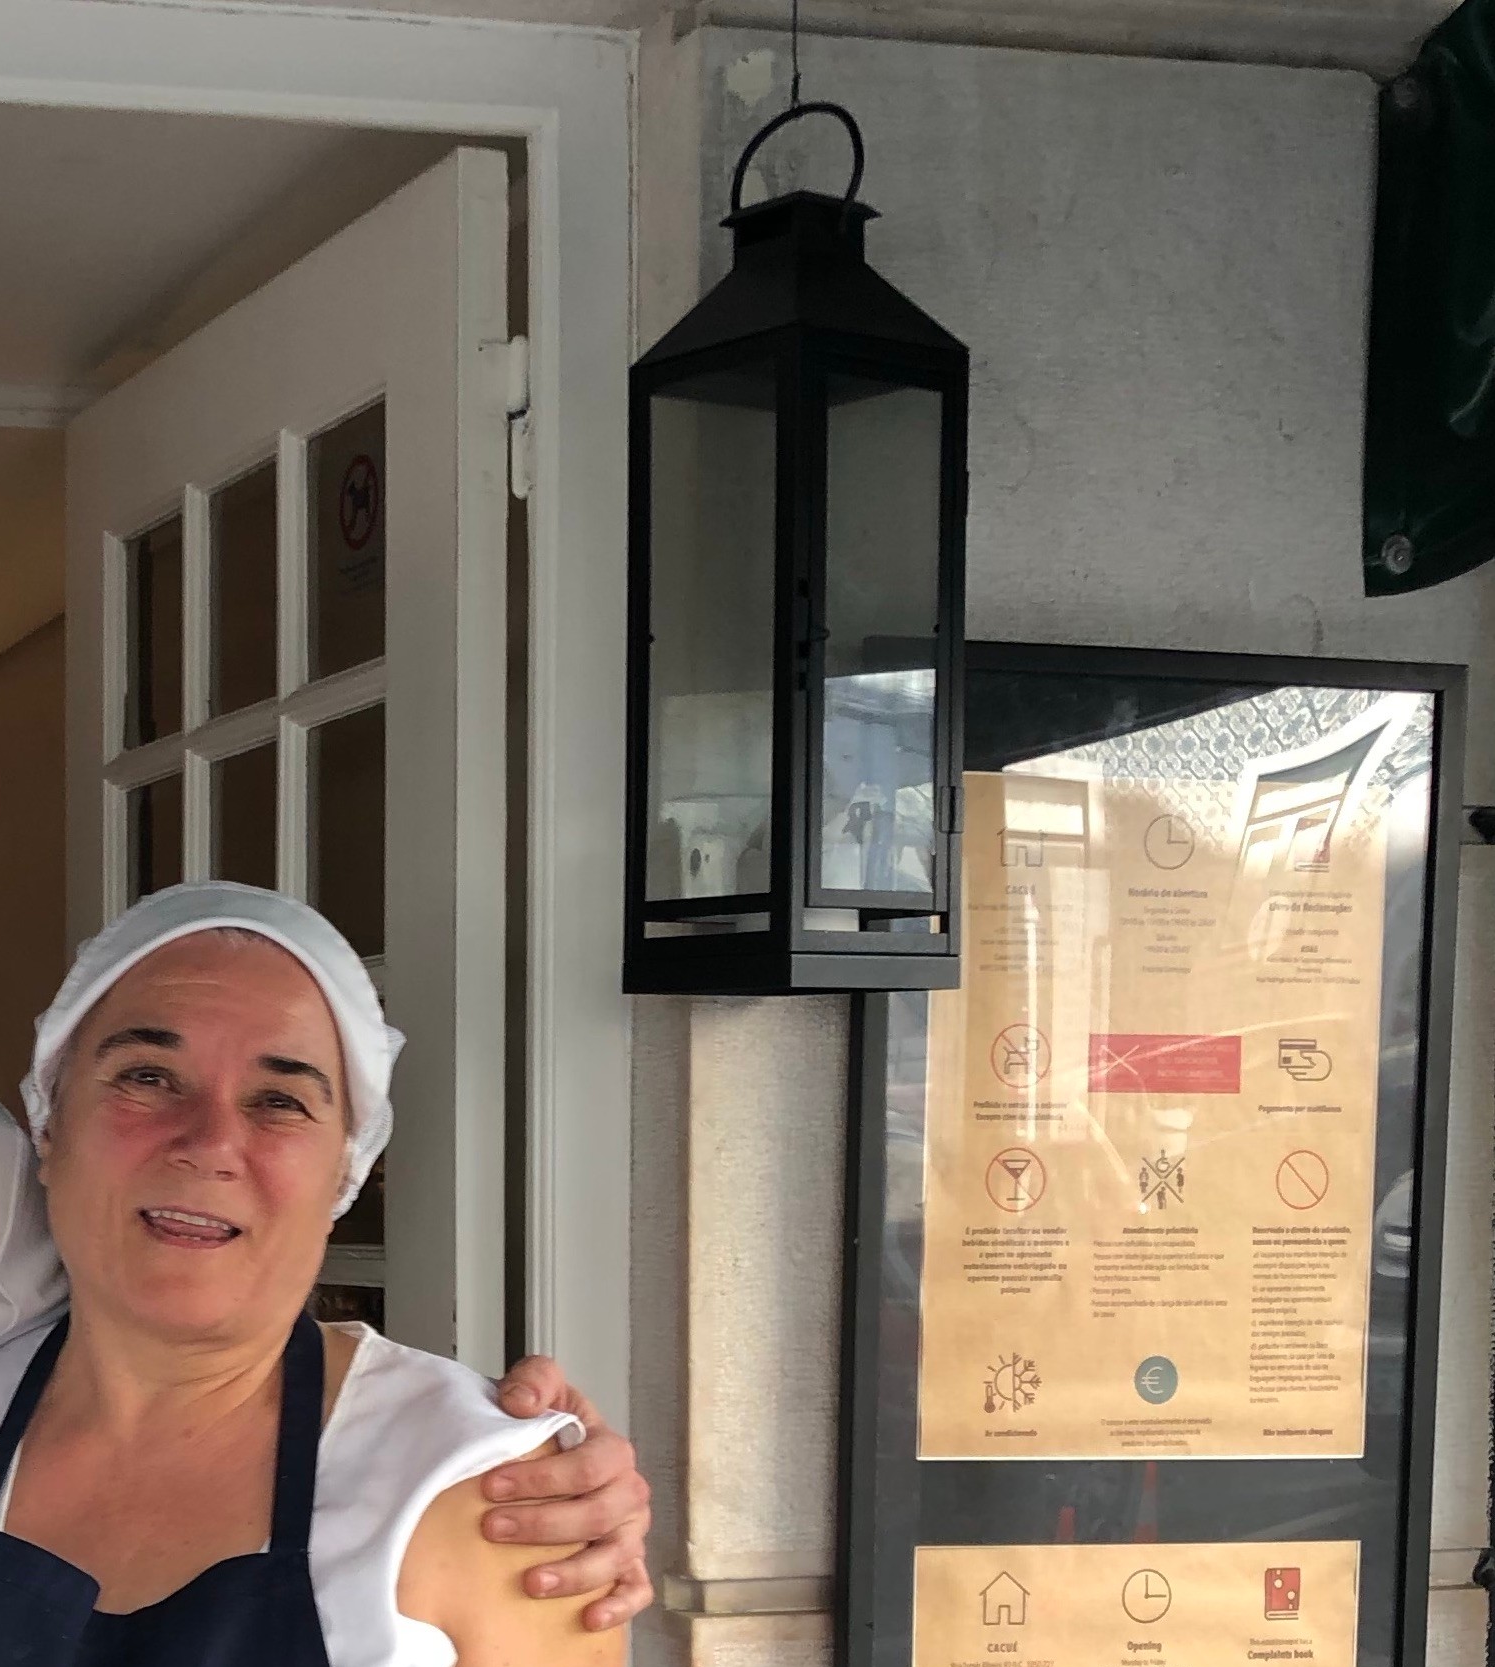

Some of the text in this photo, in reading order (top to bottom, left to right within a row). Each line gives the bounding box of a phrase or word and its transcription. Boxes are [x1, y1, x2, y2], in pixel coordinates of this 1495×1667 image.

[1127, 1640, 1162, 1653] Opening
[1247, 1649, 1313, 1662] Complaints book
